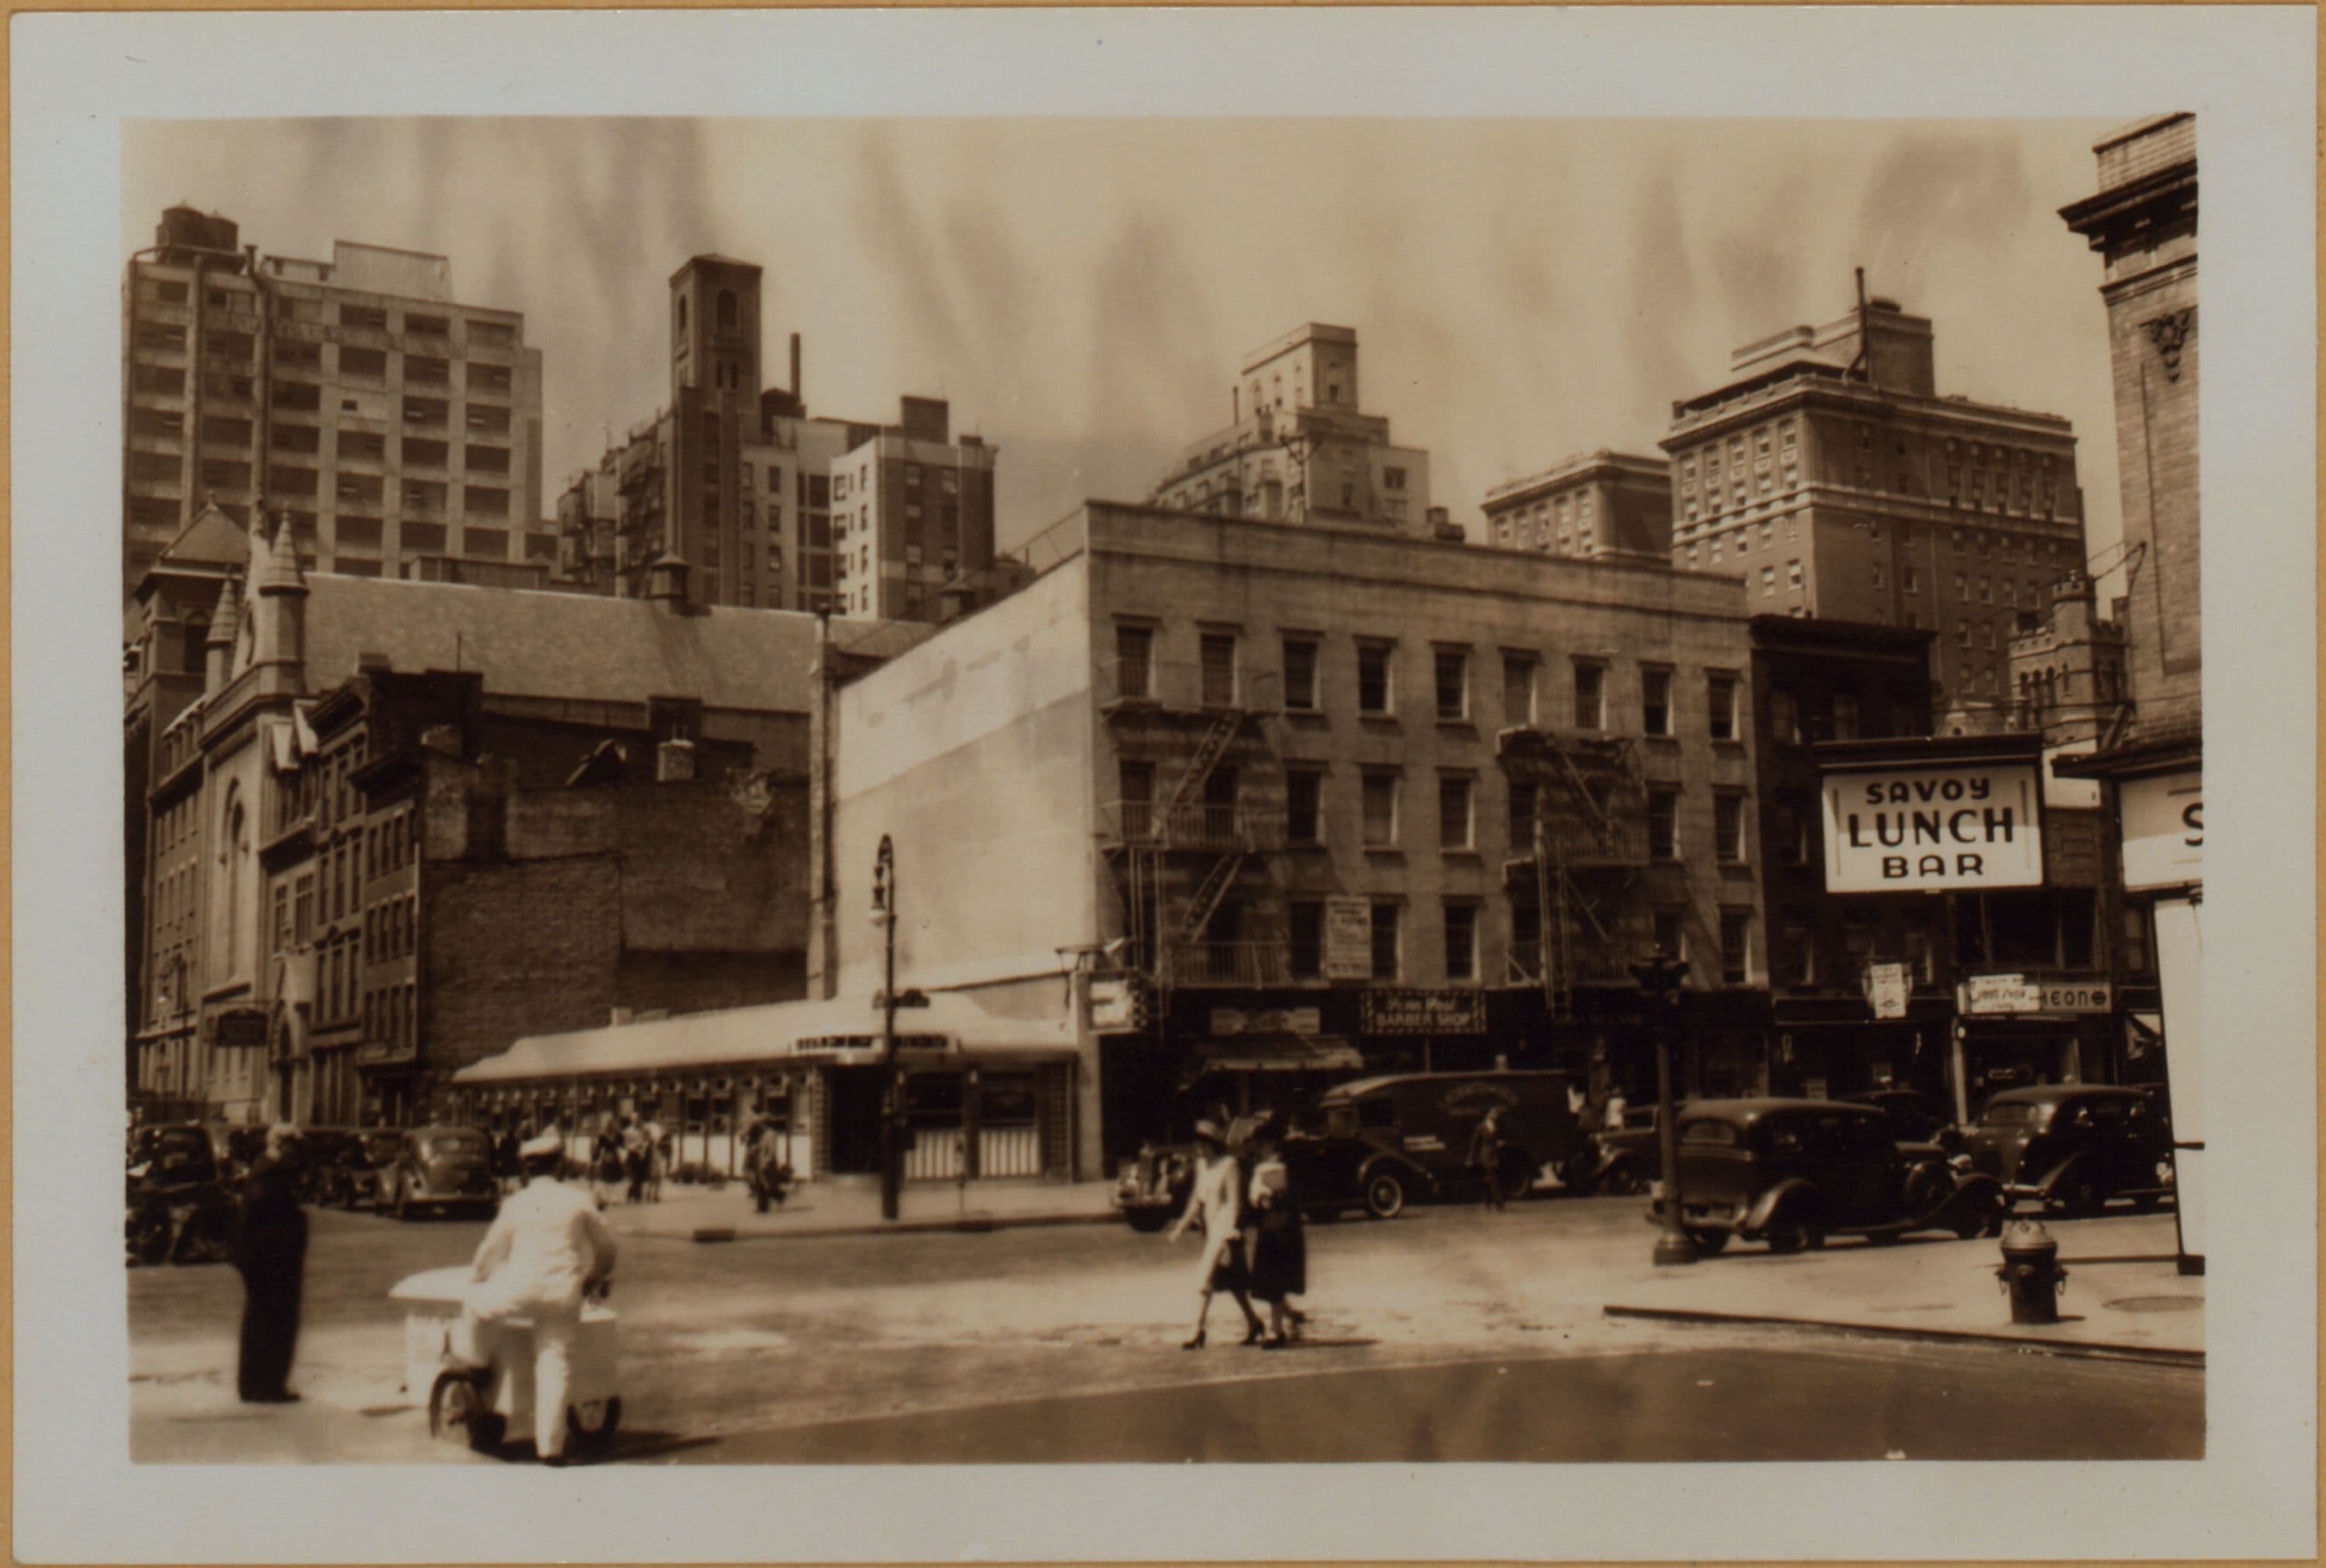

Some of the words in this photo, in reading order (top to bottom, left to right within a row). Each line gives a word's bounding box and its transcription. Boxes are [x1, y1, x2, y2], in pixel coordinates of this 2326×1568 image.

[1866, 778, 1990, 805] SAVOY
[1849, 808, 2013, 847] LUNCH
[1883, 854, 1983, 878] BAR
